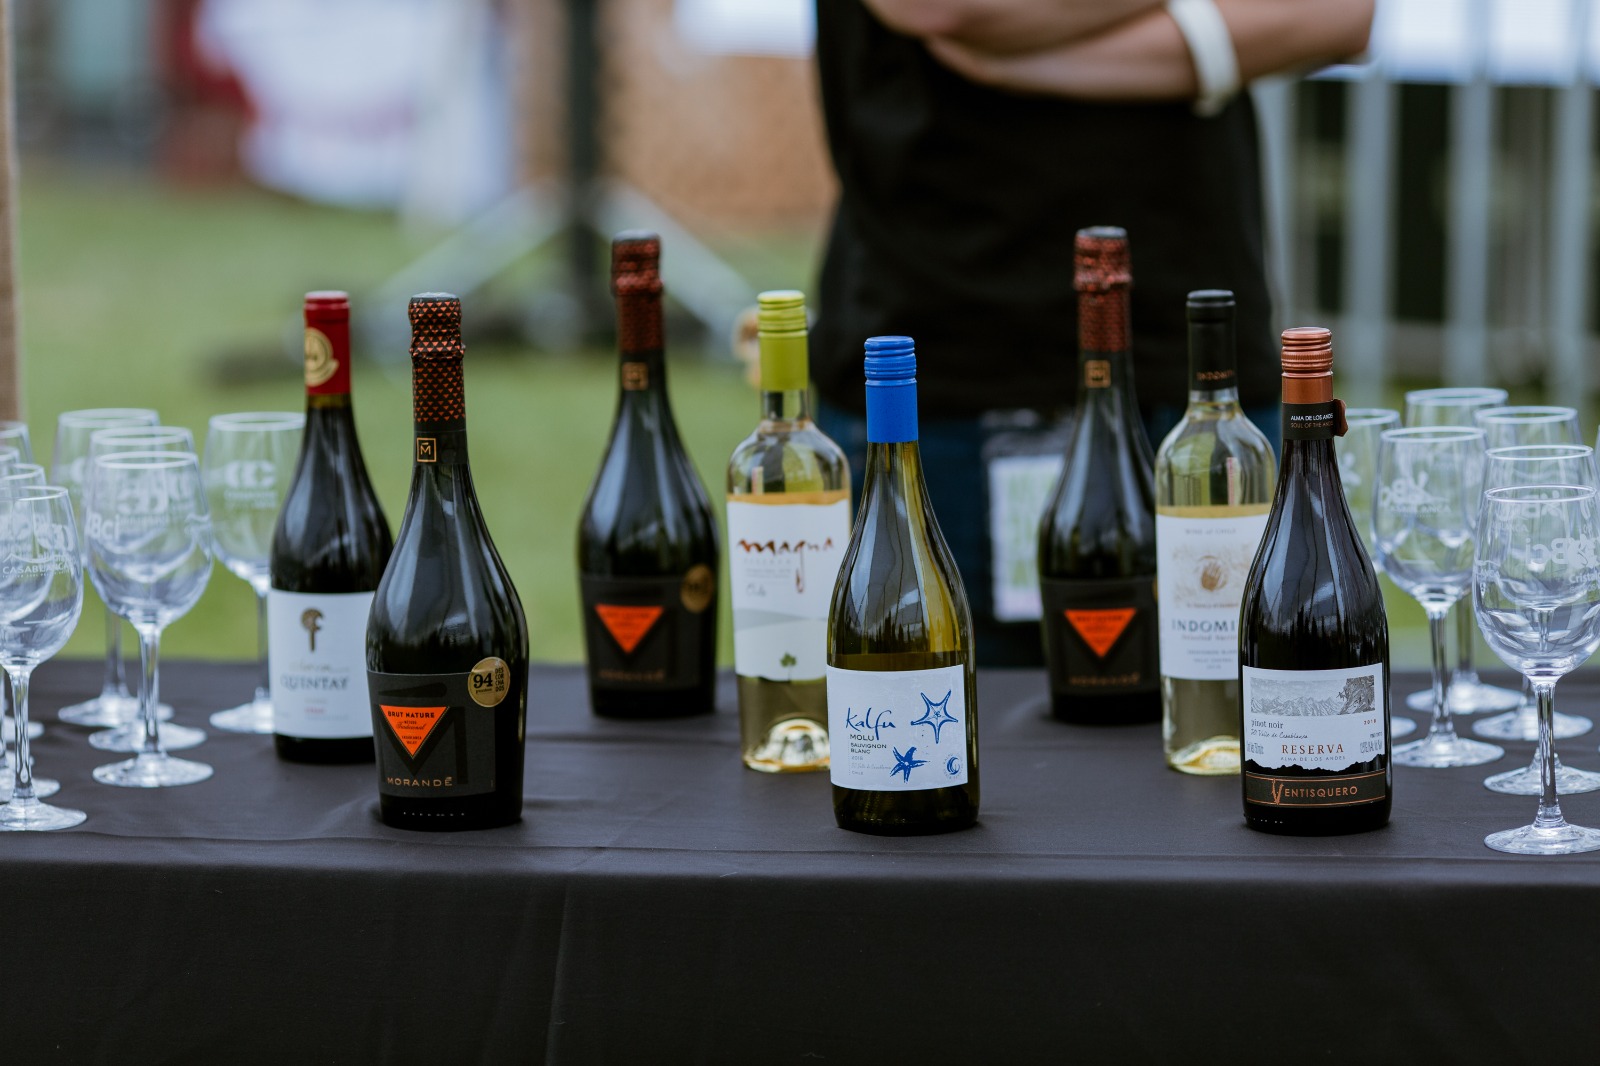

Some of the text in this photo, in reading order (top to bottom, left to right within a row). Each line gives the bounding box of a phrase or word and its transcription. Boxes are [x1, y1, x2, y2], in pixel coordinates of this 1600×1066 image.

[1171, 619, 1238, 633] INDOMI
[473, 672, 493, 689] 94
[387, 710, 403, 718] BRUT
[1250, 719, 1284, 729] pinot noir
[849, 733, 875, 741] MOLU
[1281, 743, 1344, 755] RESERVA
[387, 776, 453, 787] MORANDÉ
[1271, 777, 1358, 805] VENTISQUERO
